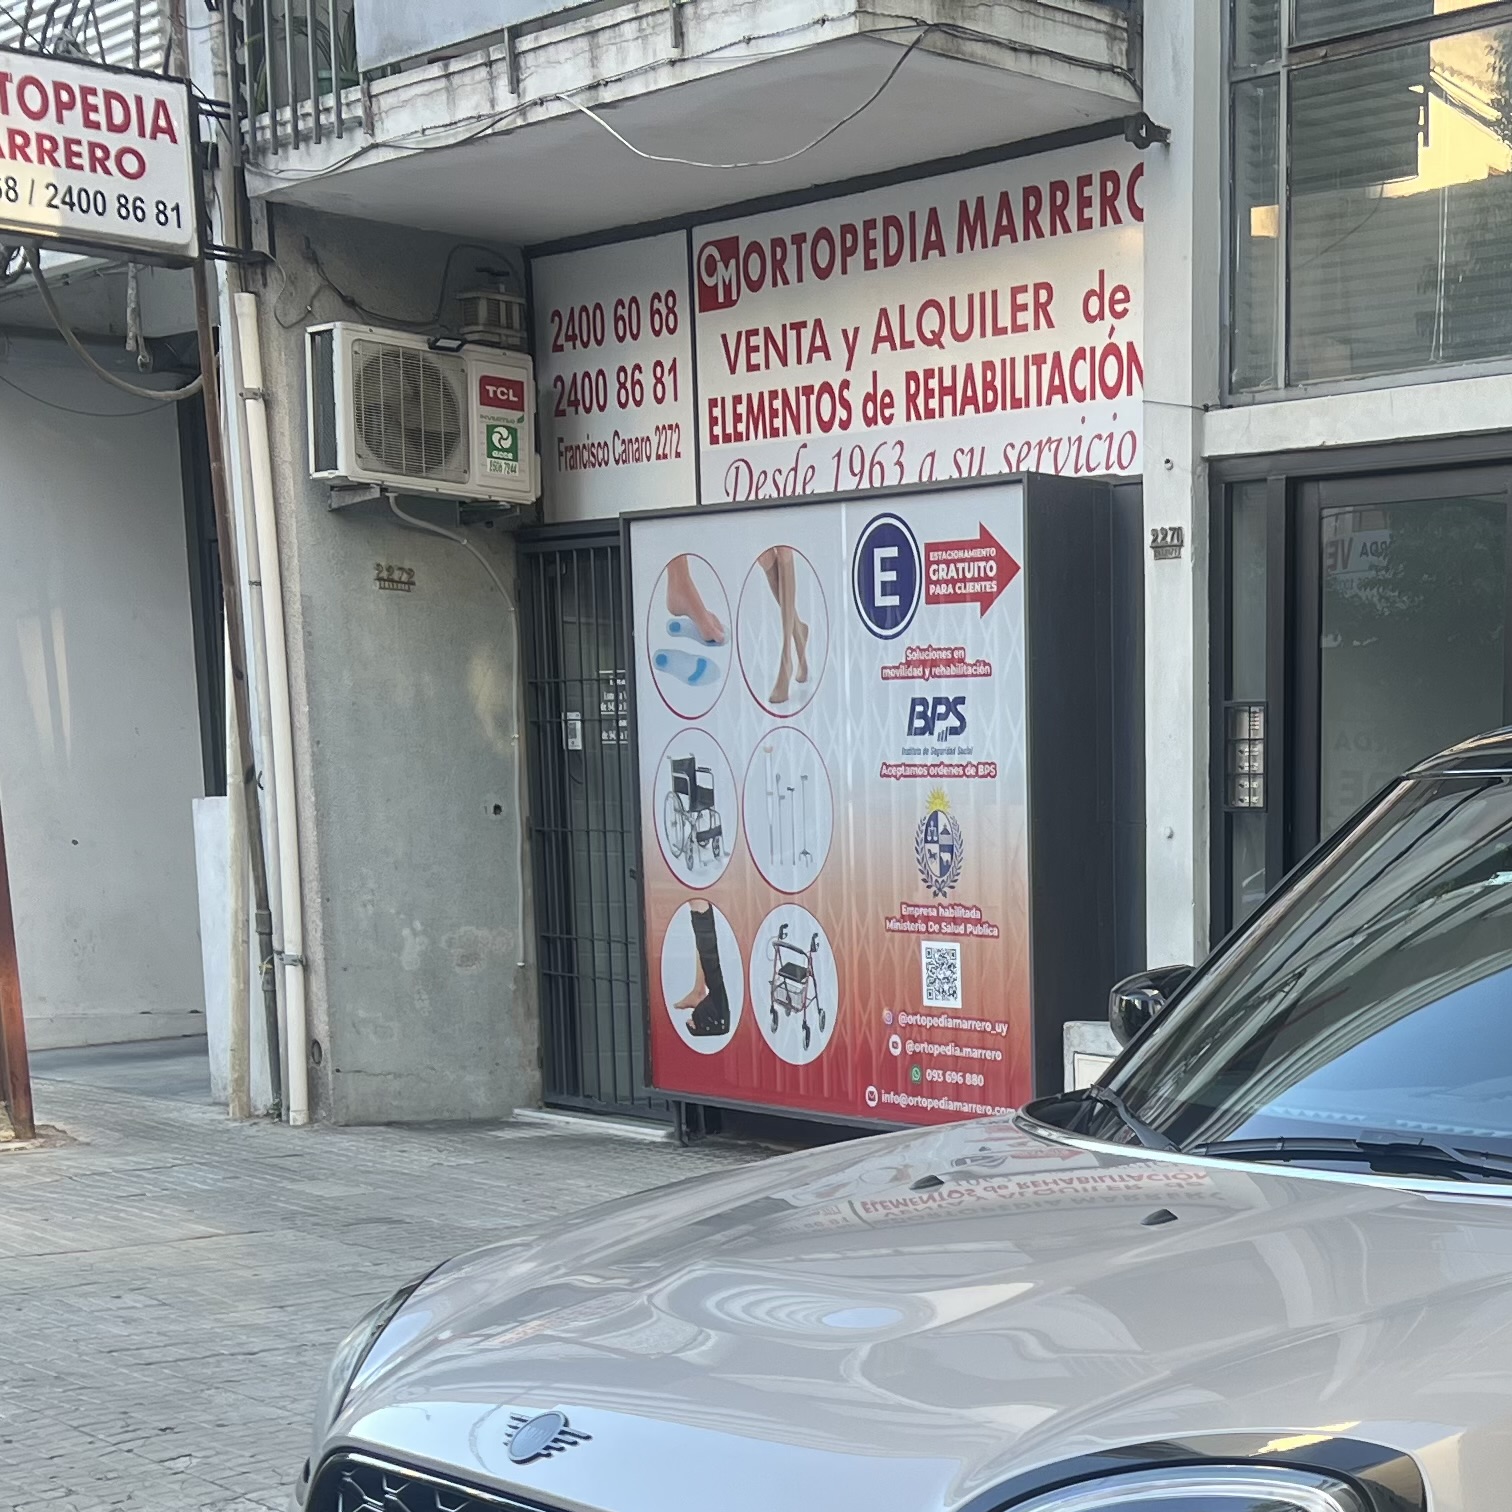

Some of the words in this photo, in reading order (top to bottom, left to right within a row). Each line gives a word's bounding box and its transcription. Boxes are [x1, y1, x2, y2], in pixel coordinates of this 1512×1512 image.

[45, 183, 107, 217] 2400
[117, 194, 146, 223] 86
[156, 200, 182, 229] 81
[742, 206, 946, 293] ORTOPEDIA
[550, 302, 605, 353] 2400
[614, 296, 641, 343] 60
[650, 289, 678, 337] 68
[720, 318, 832, 375] VENTA
[842, 326, 860, 372] y
[871, 281, 1055, 355] ALQUILER
[1083, 269, 1131, 324] de
[485, 385, 518, 402] TCL
[554, 369, 607, 418] 2400
[616, 363, 644, 410] 86
[653, 357, 678, 404] 81
[708, 378, 852, 446] ELEMENTOS
[862, 370, 894, 428] de
[558, 433, 609, 472] Francisco
[612, 429, 651, 466] Canaro
[655, 422, 681, 461] 2272
[724, 443, 816, 501] Desde
[832, 438, 905, 493] 1963
[952, 445, 986, 480] su
[1003, 412, 1138, 475] servicio
[929, 548, 996, 561] ESTACIONAMIENTO
[873, 546, 900, 607] E
[929, 560, 997, 581] GRATUITO
[929, 583, 954, 595] PARA
[955, 581, 997, 594] CLIENTES
[906, 647, 952, 660] Soluciones
[953, 648, 965, 659] en
[882, 665, 923, 678] movilidad
[907, 696, 967, 738] BPS
[881, 764, 928, 778] Aceptamos
[965, 762, 976, 774] de
[978, 764, 996, 776] BPS
[901, 905, 937, 917] Empresa
[938, 904, 981, 919] habilitada
[886, 918, 927, 932] Ministerio
[928, 920, 939, 932] De
[941, 921, 965, 934] Salud
[898, 1011, 1008, 1036] @ortopediamarrero_uy
[906, 1040, 1002, 1061] @ortopedia.marrero
[926, 1069, 944, 1082] 093
[945, 1070, 964, 1084] 696
